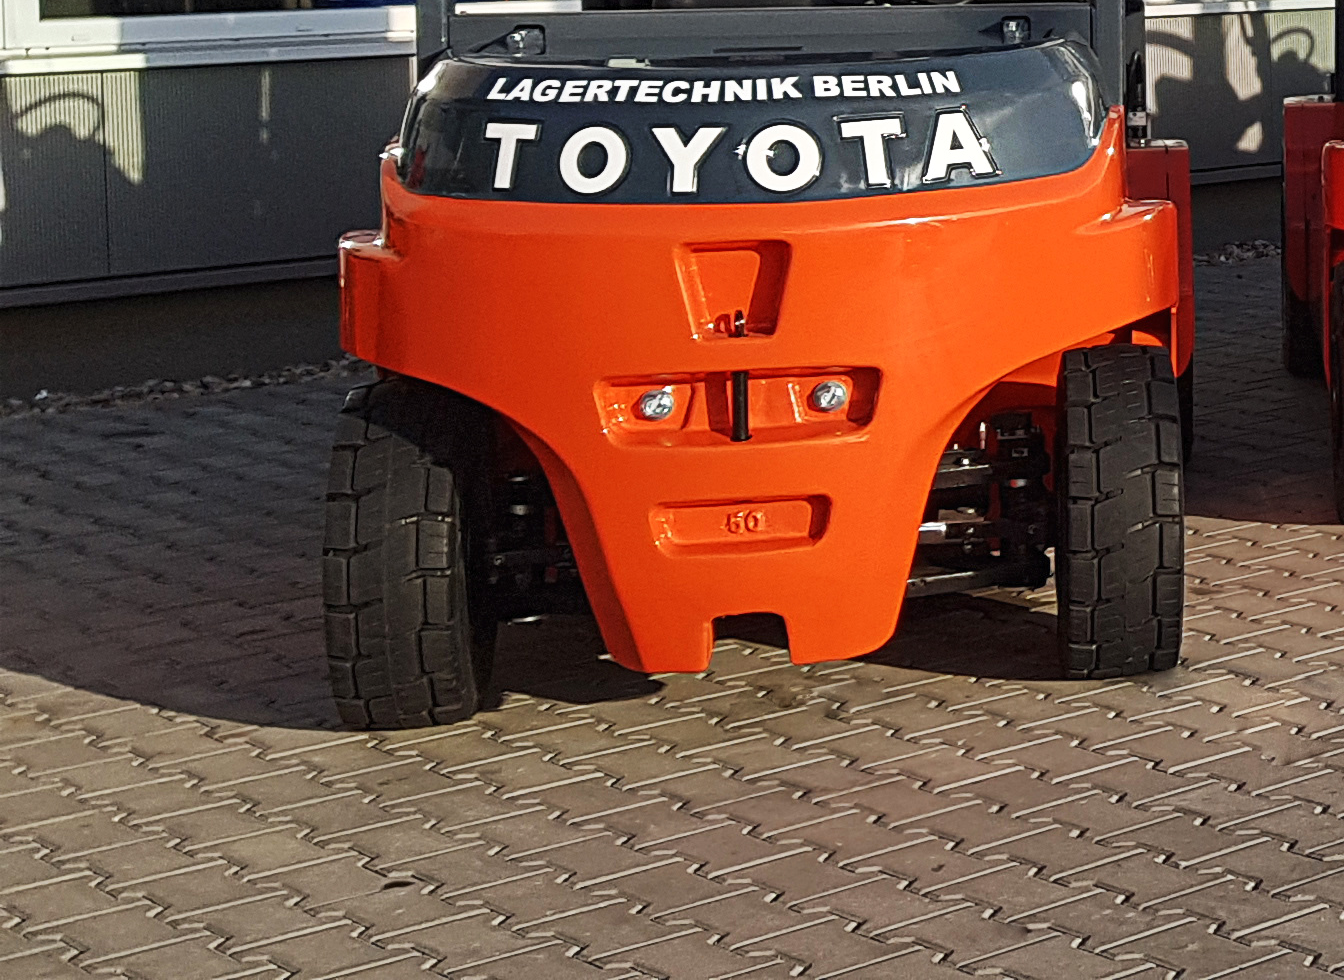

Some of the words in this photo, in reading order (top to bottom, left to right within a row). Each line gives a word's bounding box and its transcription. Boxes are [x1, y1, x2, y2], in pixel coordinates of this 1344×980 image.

[486, 75, 803, 104] LAGERTECHNIK
[813, 70, 961, 99] BERLIN
[484, 106, 999, 195] TOYOTA
